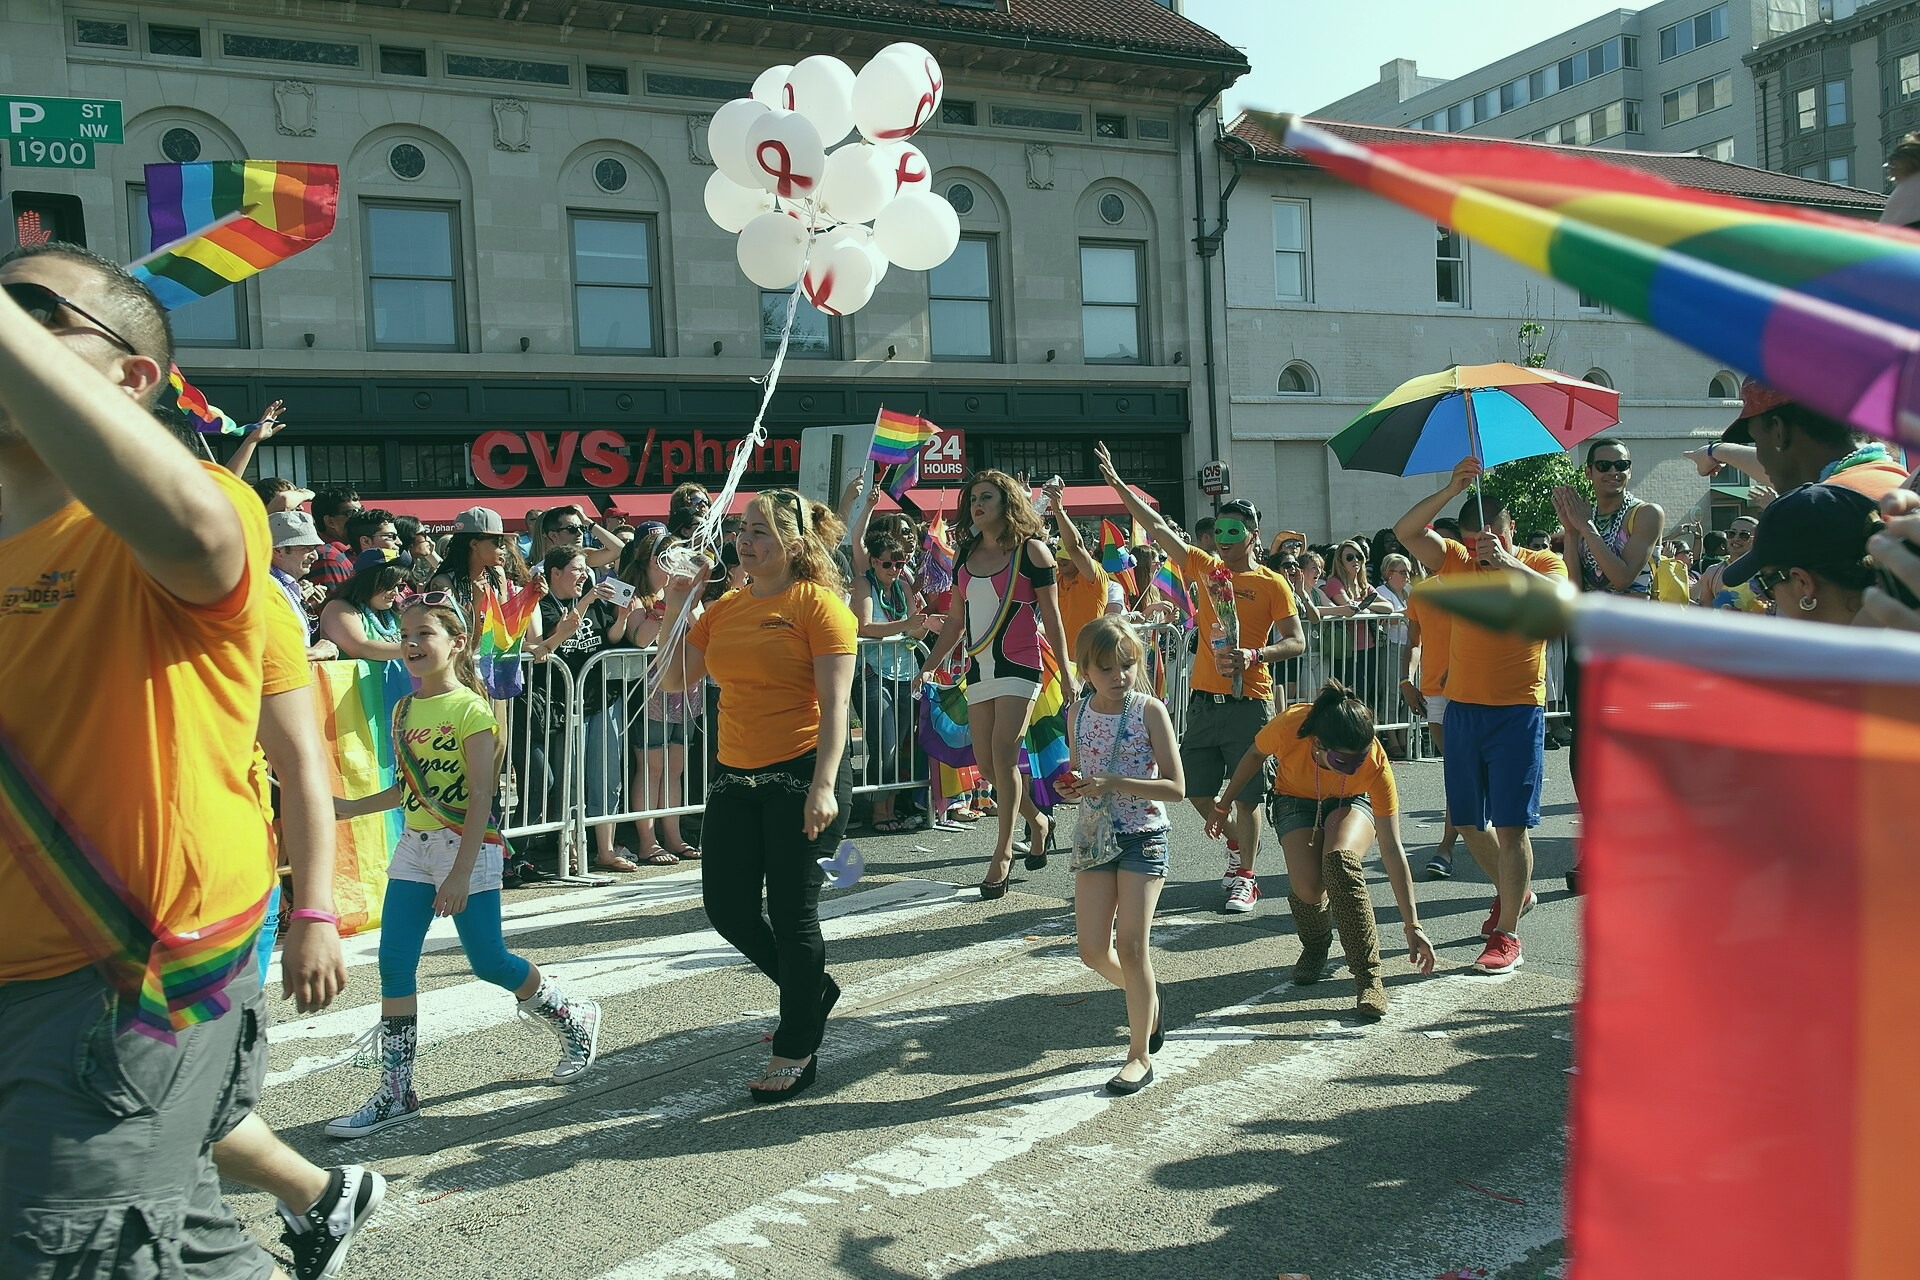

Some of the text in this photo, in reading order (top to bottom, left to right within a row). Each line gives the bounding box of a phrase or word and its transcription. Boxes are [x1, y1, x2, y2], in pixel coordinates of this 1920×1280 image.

[9, 101, 105, 134] P ST
[79, 123, 109, 138] NW
[18, 140, 87, 165] 1900
[923, 434, 962, 461] 24
[924, 463, 963, 475] HOURS
[1204, 465, 1221, 478] CVS
[417, 757, 461, 776] you
